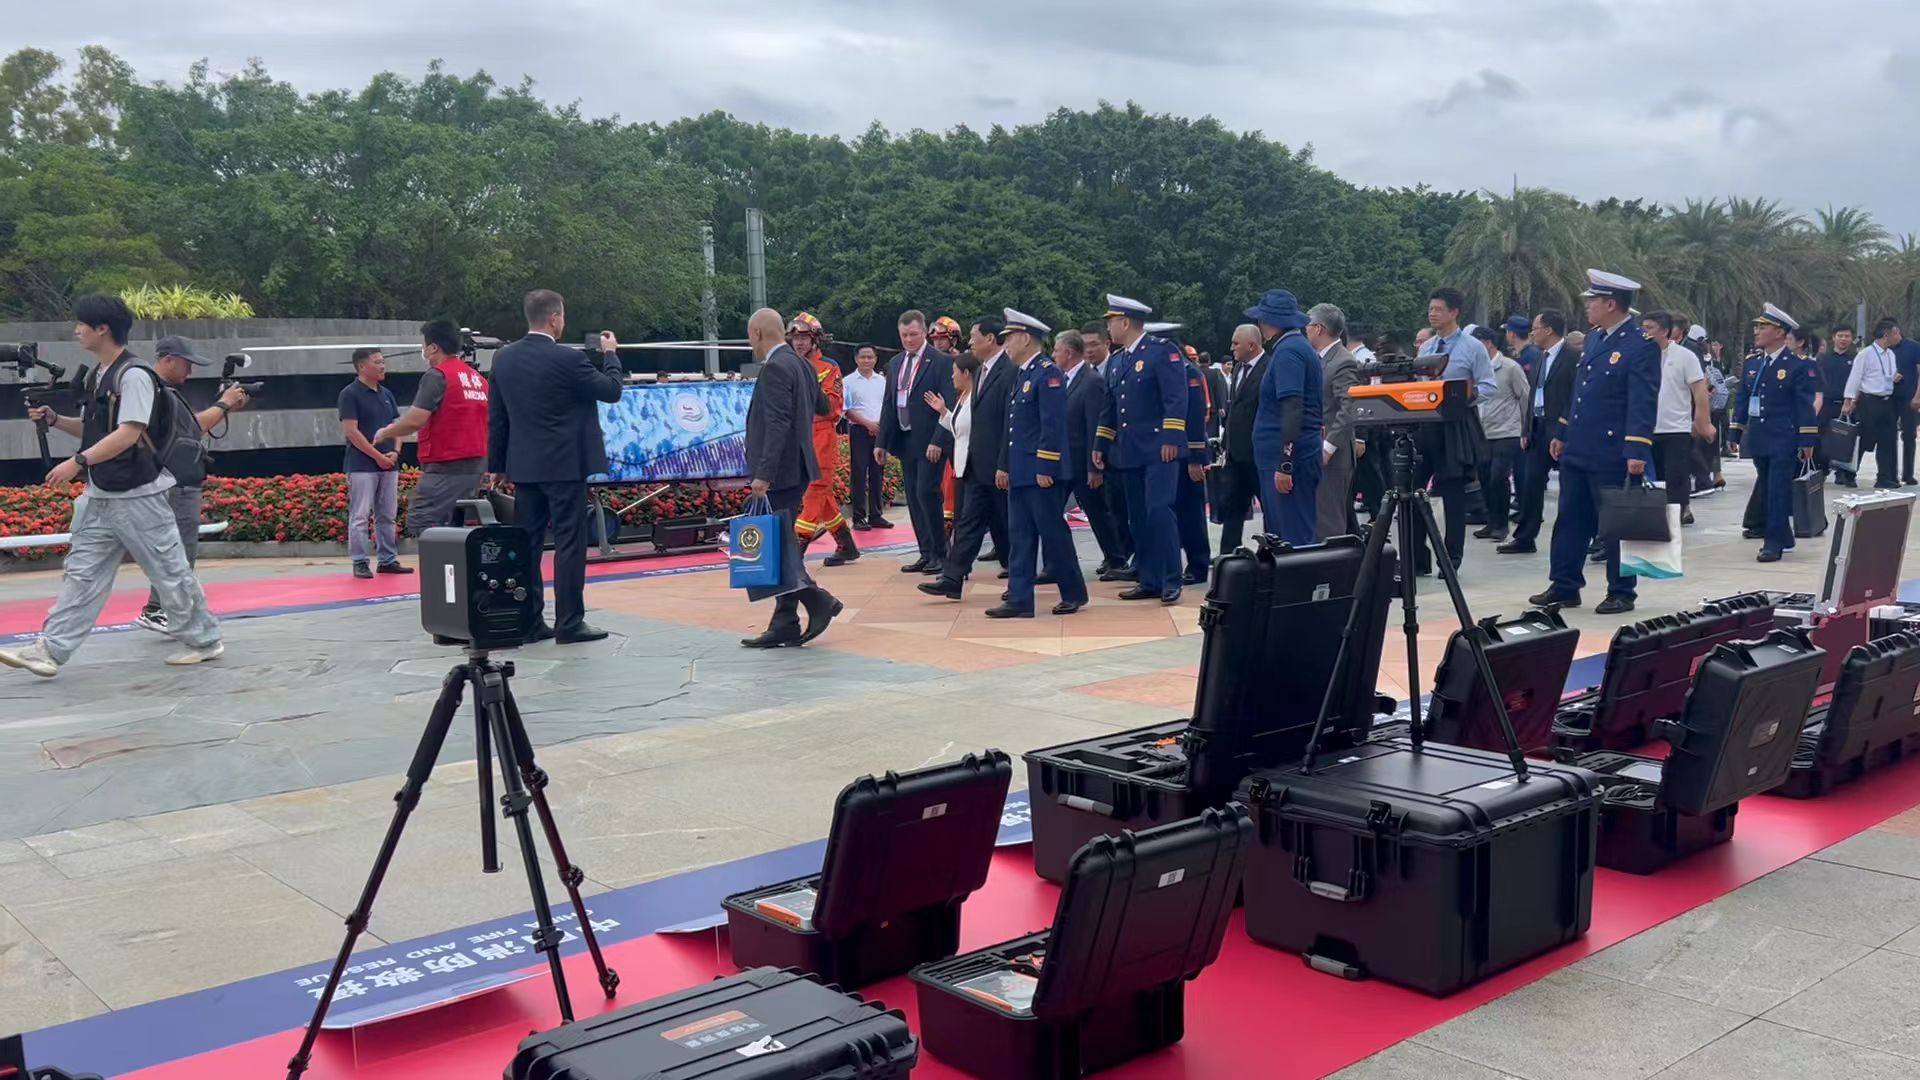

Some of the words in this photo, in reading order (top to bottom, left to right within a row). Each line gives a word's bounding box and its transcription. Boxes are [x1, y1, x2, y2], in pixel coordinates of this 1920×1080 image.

[523, 909, 594, 929] CHIA
[467, 927, 518, 943] FIRE
[405, 941, 457, 959] AND
[293, 957, 397, 987] RESUE
